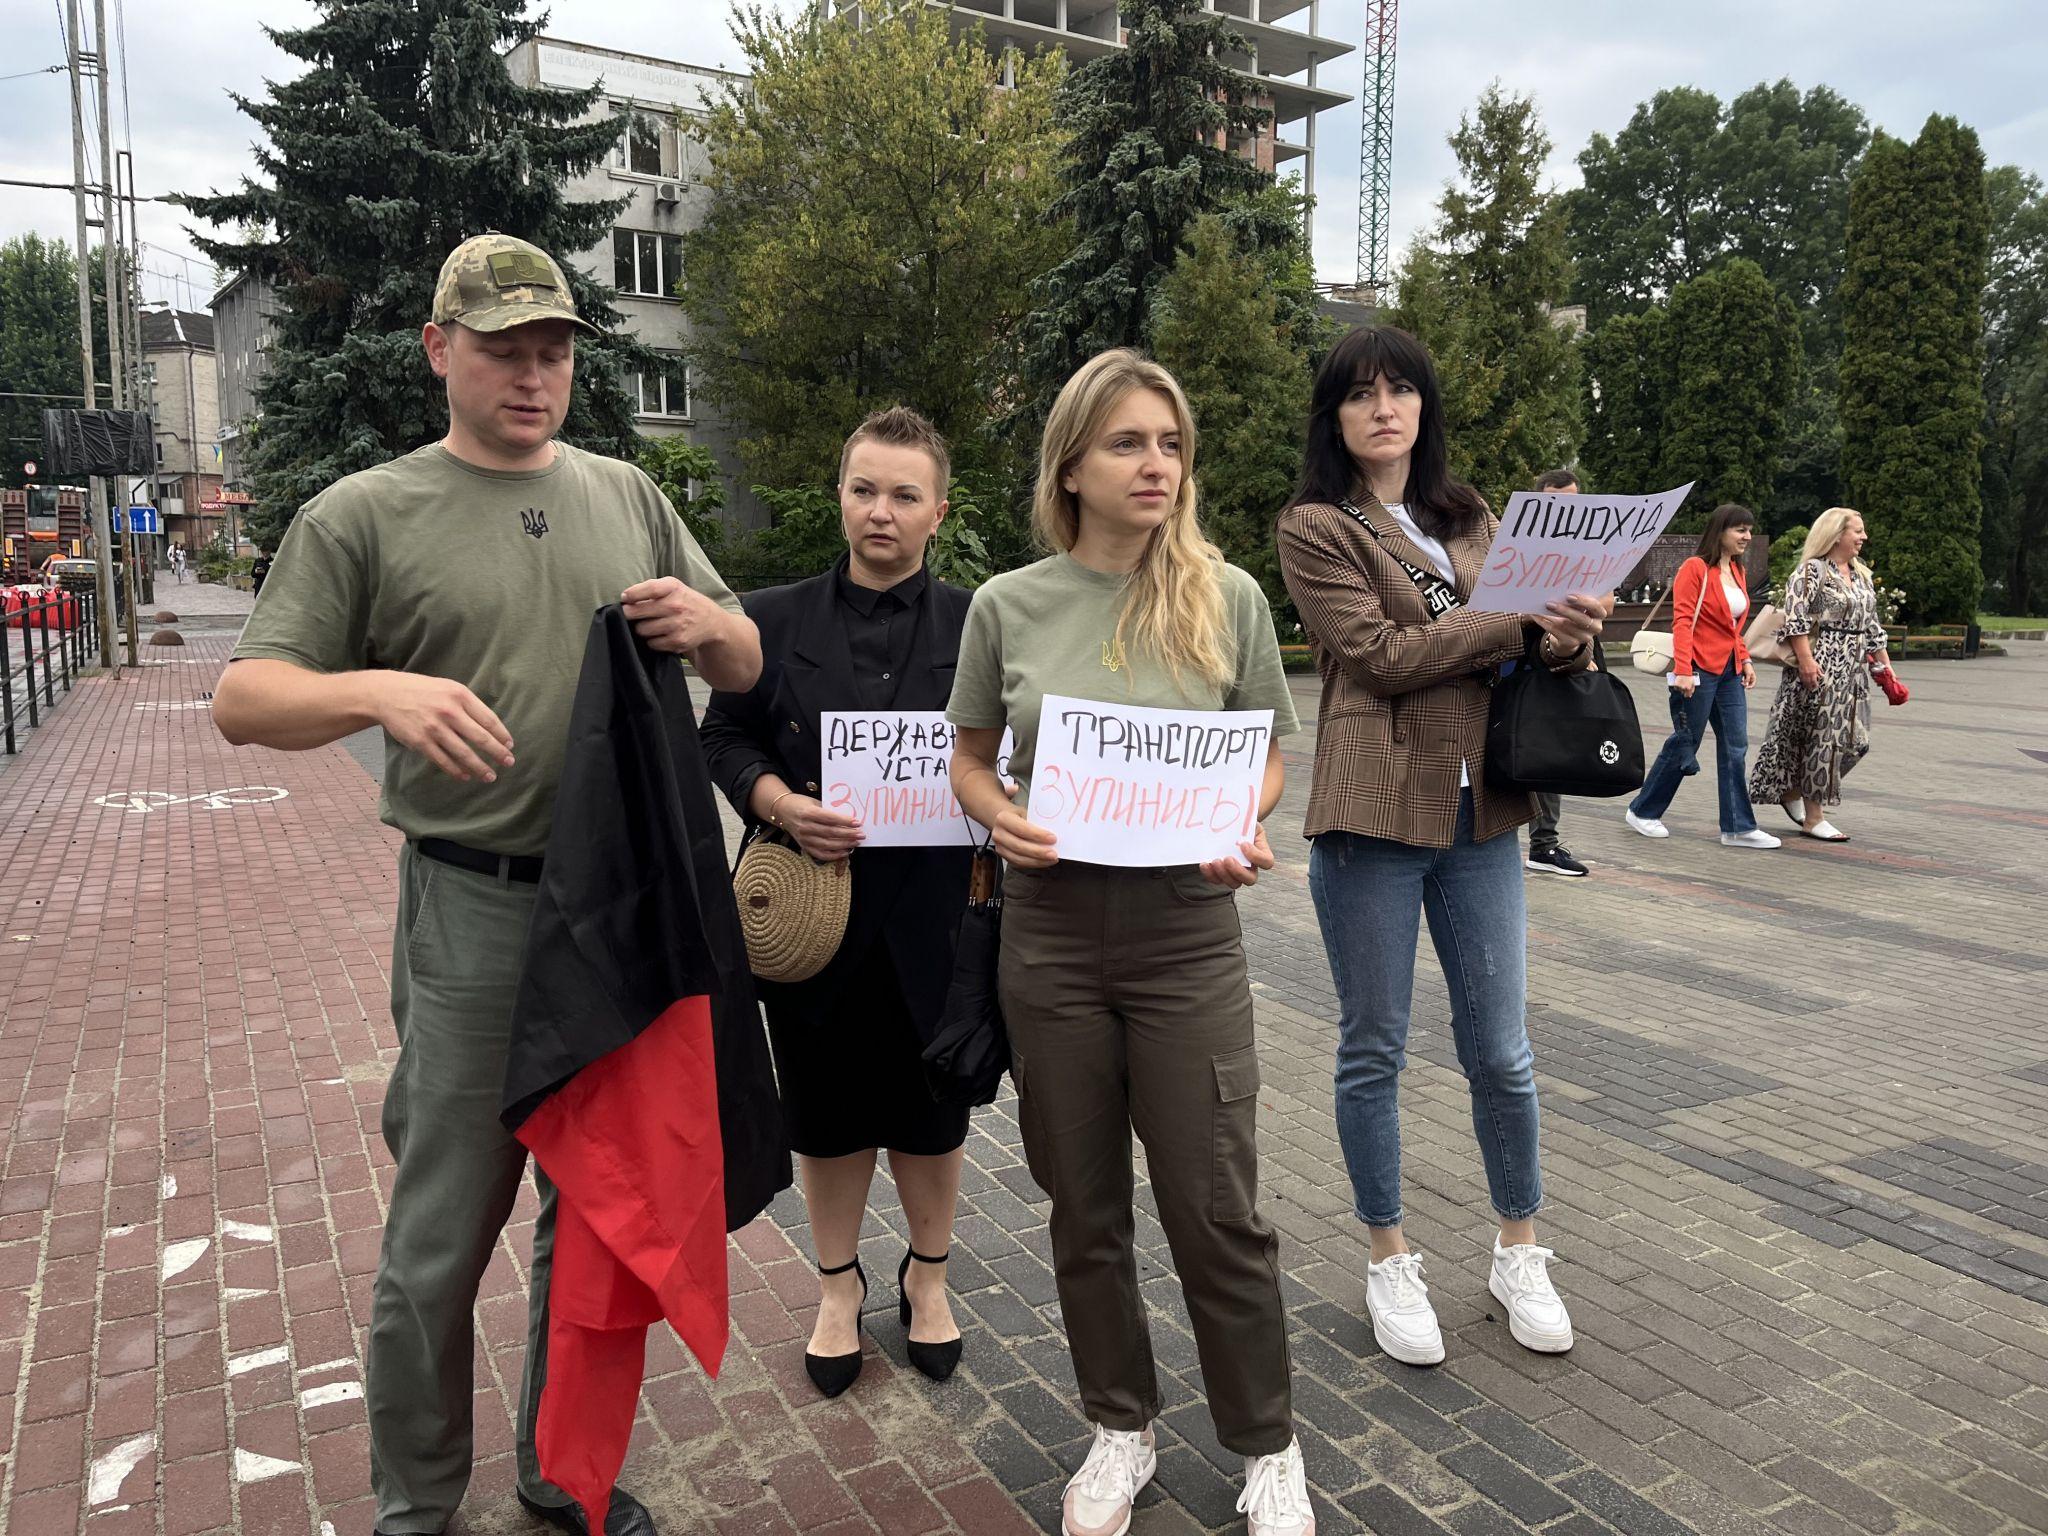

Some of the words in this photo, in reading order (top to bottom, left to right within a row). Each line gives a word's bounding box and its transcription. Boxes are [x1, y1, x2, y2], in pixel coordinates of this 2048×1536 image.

[1512, 496, 1663, 545] ПІШОХІД
[1062, 711, 1267, 769] ТРАНСПОРТ
[1035, 764, 1255, 845] ЗУПИНИСЬ!
